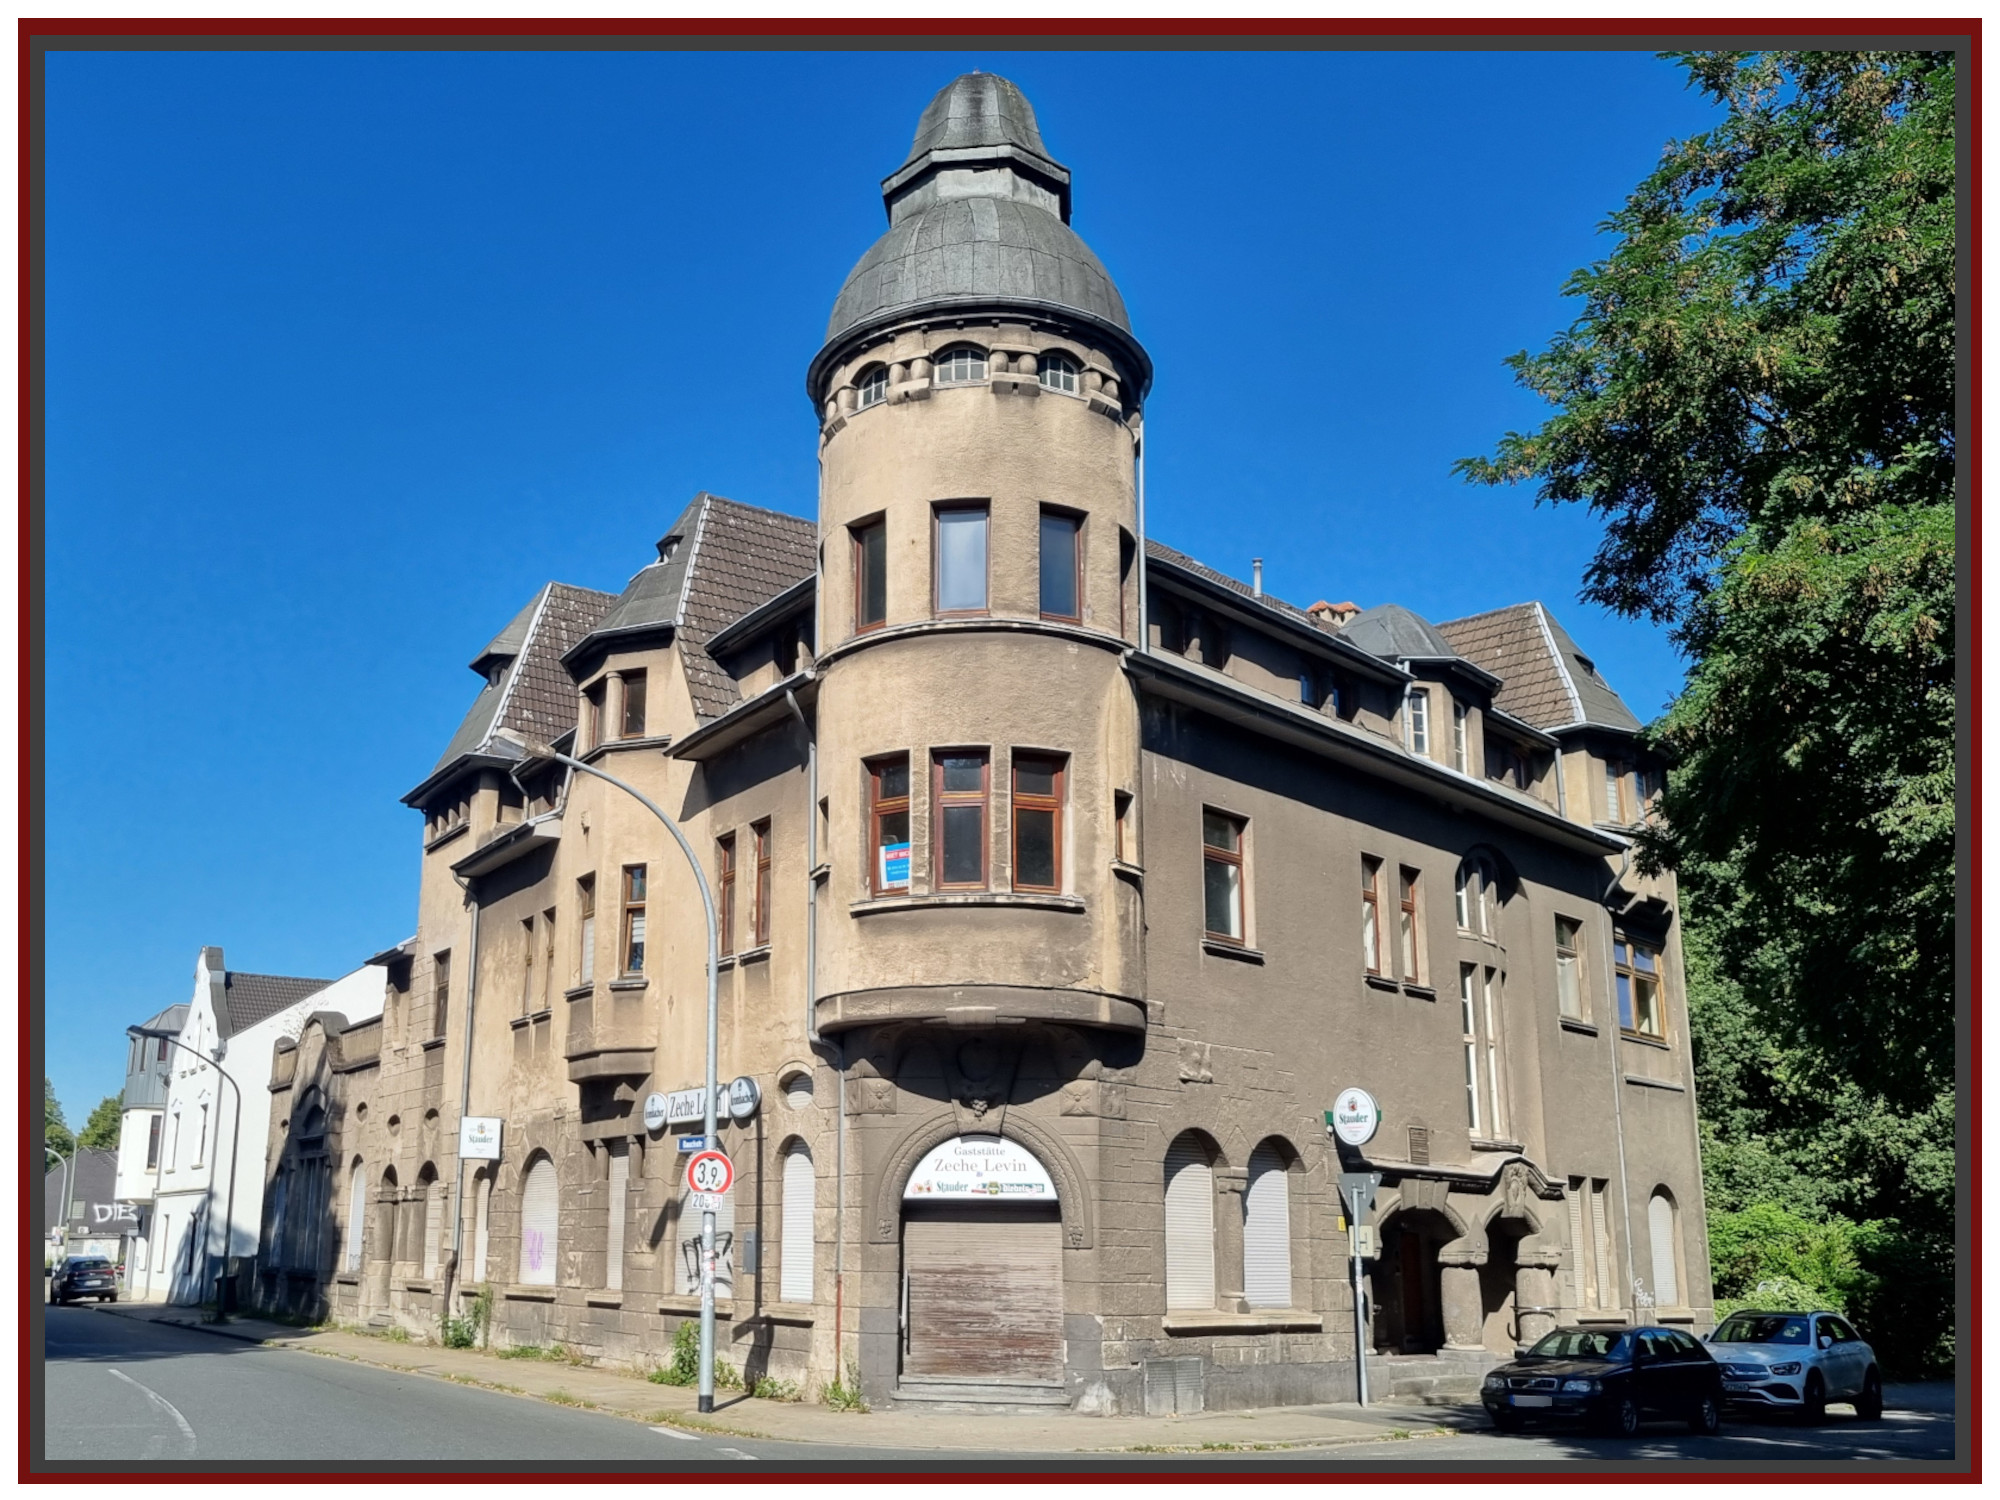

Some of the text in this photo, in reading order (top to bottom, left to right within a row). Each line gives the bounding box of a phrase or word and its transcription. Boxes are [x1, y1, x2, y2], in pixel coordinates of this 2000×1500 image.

[669, 1094, 694, 1118] Zeche
[1339, 1112, 1368, 1125] Stauder
[954, 1146, 1006, 1156] Gaststätte
[934, 1158, 1027, 1172] Zeche Levin
[697, 1162, 718, 1186] 3,9
[936, 1180, 968, 1193] Stauder
